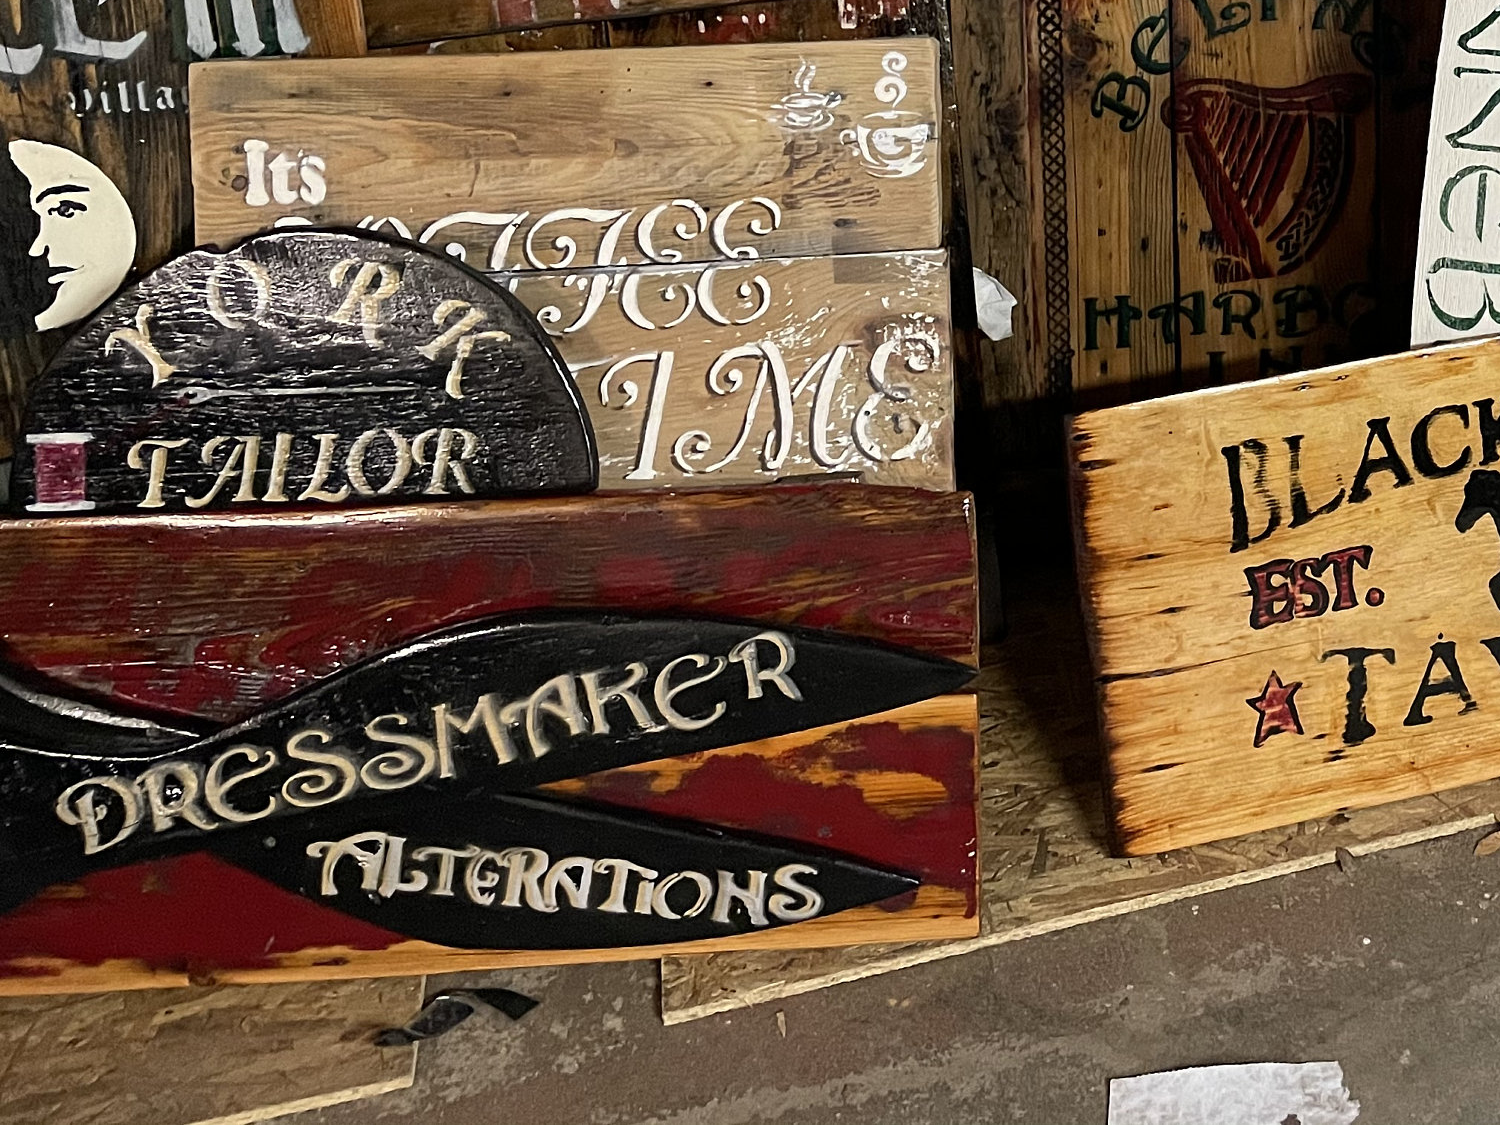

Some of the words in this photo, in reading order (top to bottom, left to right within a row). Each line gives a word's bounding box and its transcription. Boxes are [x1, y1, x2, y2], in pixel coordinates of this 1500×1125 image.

[105, 256, 512, 402] YORK
[126, 426, 481, 512] TAILOR
[1243, 544, 1386, 632] EST.
[55, 628, 805, 859] DRESSMAKER
